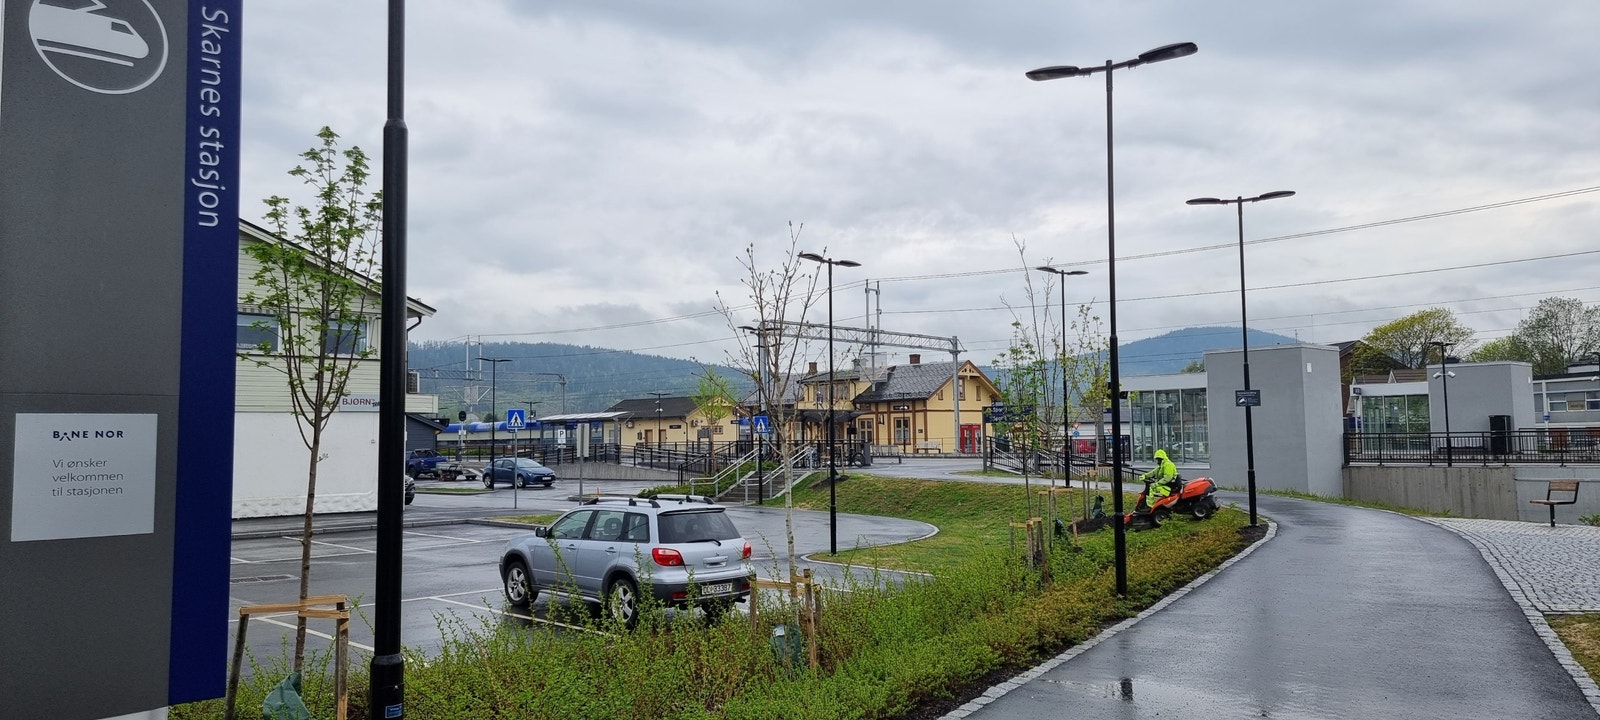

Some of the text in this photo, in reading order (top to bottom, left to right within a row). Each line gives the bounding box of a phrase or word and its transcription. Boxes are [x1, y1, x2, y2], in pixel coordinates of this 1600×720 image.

[191, 6, 230, 228] Skarnes stasjon
[52, 430, 124, 441] BANE NOR
[559, 430, 564, 438] P
[52, 459, 107, 468] Vi ønsker
[52, 473, 124, 483] velkommen
[52, 486, 123, 497] til stasjonen
